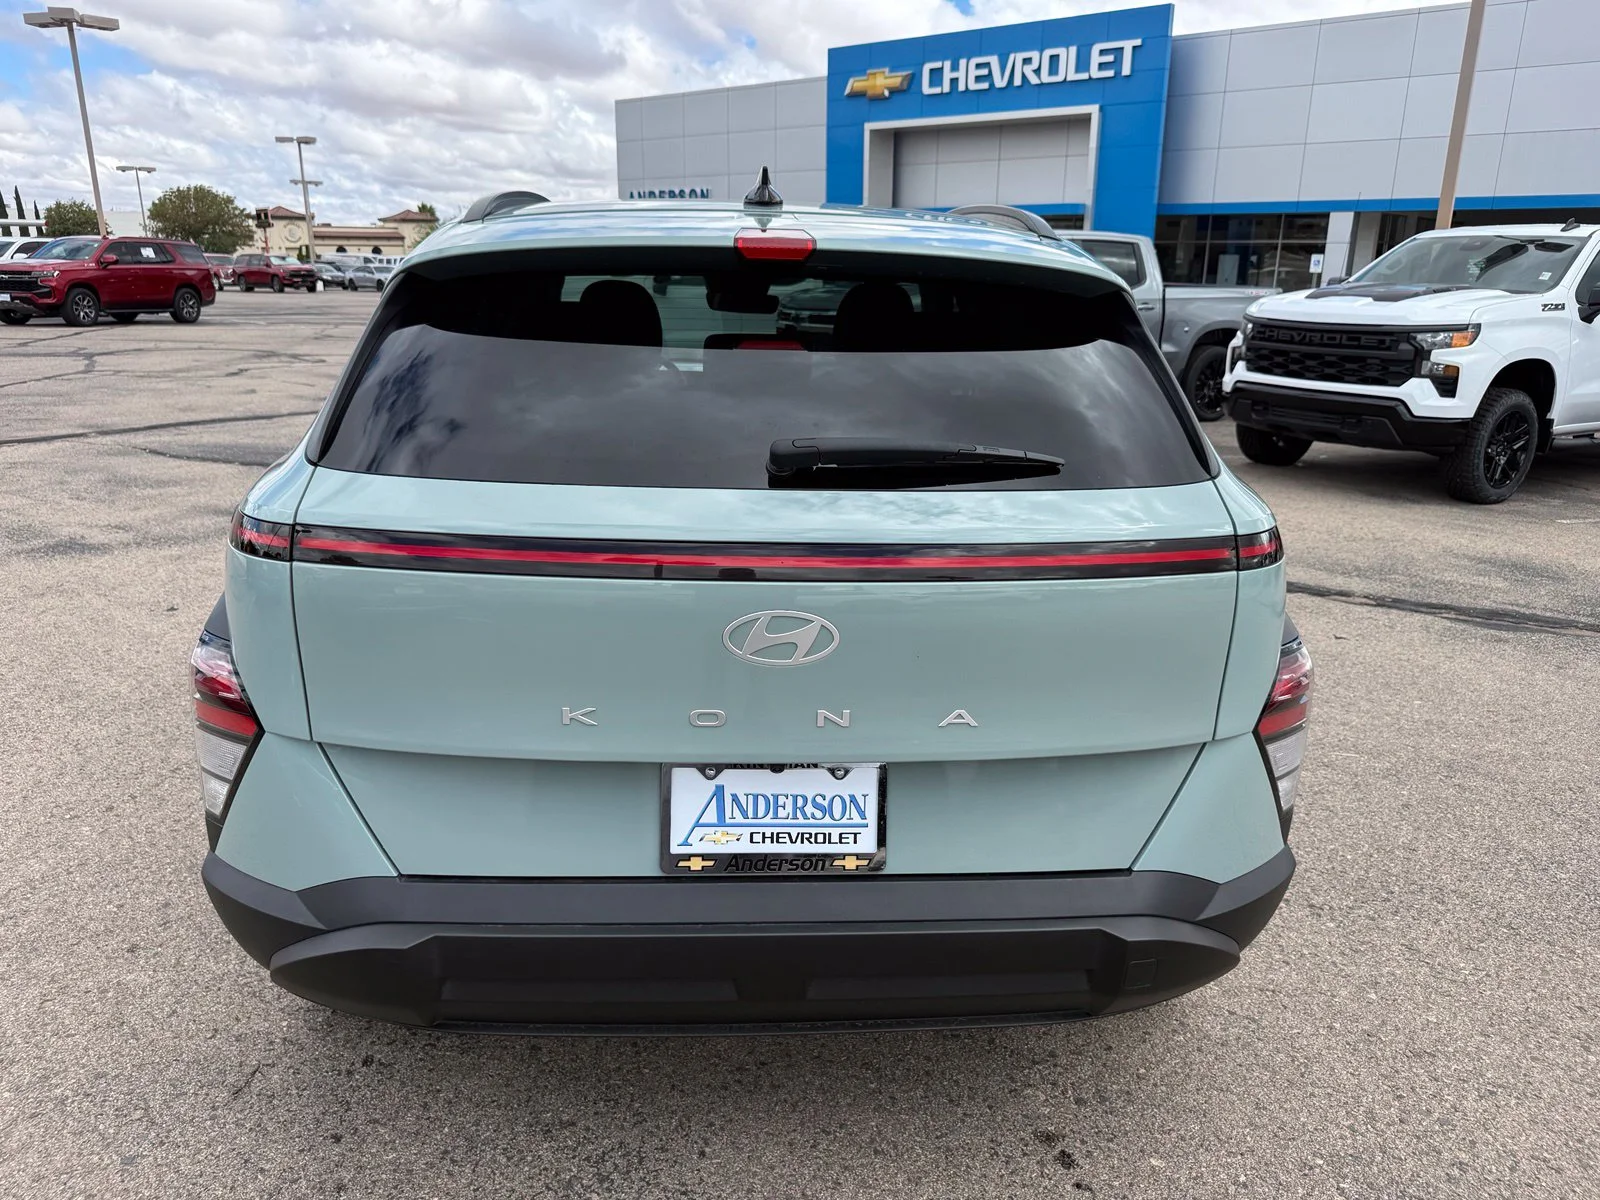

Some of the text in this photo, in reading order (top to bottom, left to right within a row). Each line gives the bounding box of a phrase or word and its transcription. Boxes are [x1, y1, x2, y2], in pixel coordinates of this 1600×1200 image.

[921, 38, 1143, 95] CHEVROLET
[1254, 328, 1397, 348] CHEVROLET
[561, 707, 978, 727] KONA
[677, 784, 869, 846] ANDERSON
[749, 831, 862, 845] CHEVROLET
[724, 855, 827, 873] Anderson
